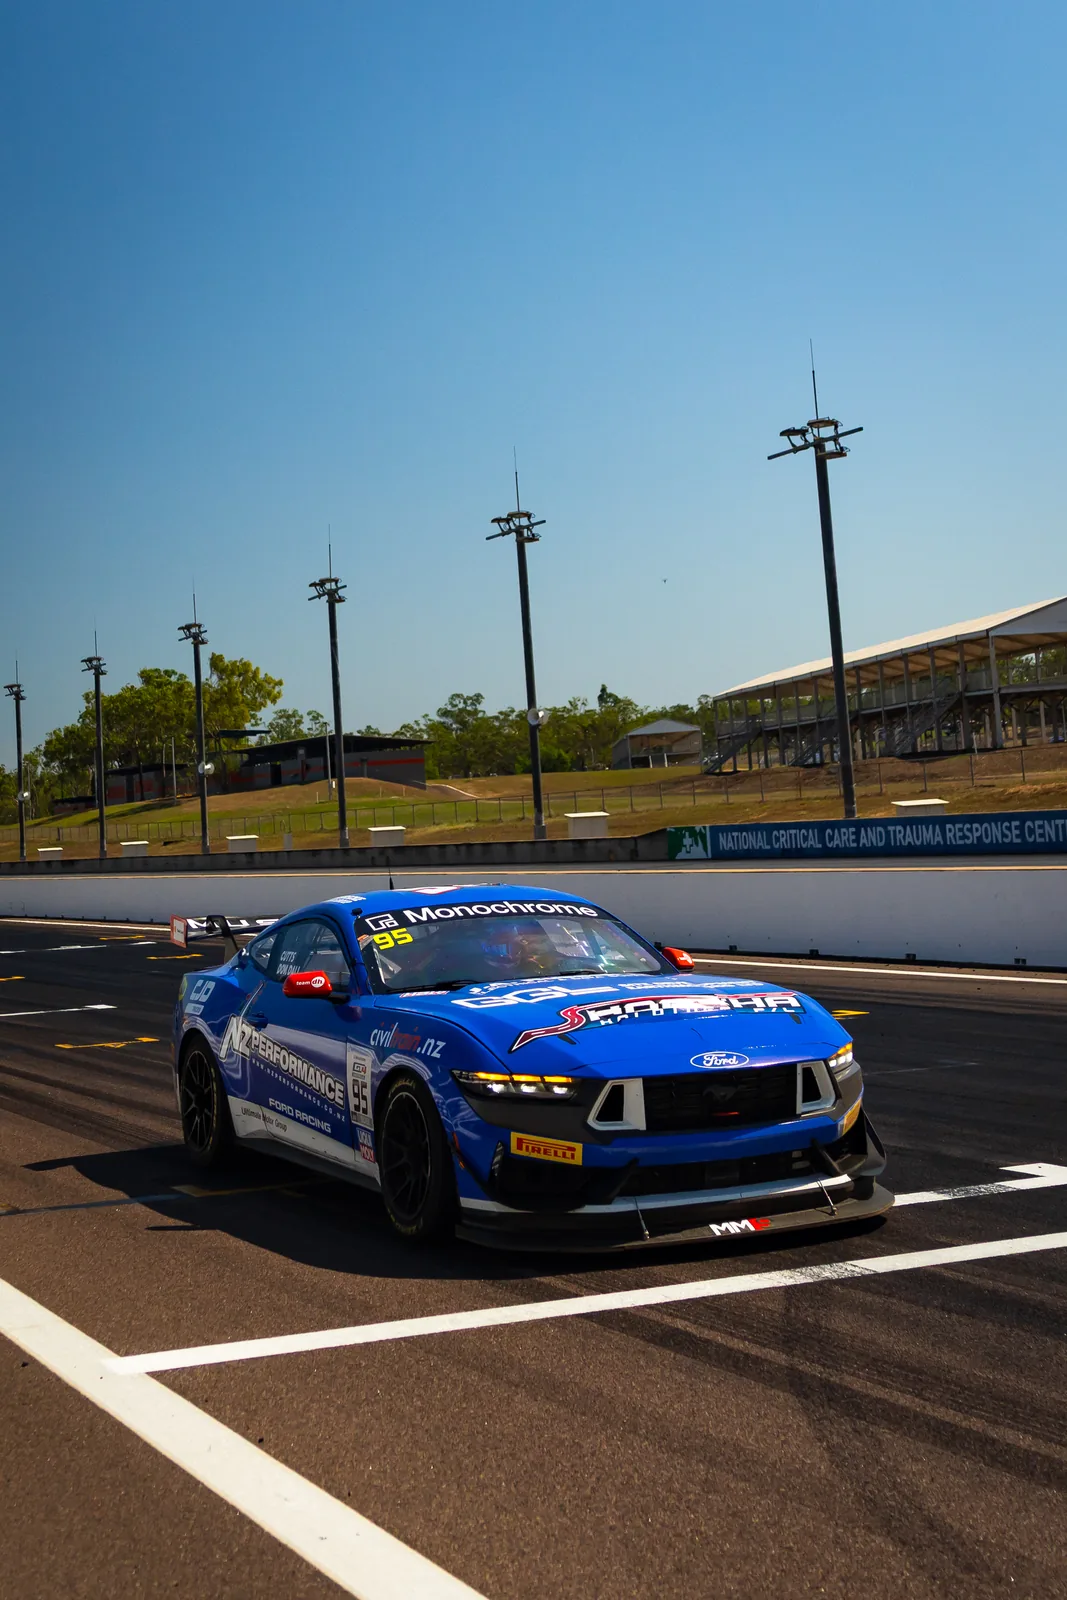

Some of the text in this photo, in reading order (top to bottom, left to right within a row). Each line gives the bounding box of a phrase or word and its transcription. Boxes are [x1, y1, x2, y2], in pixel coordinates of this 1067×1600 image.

[719, 819, 1067, 850] NATIONAL CRITICAL CARE AND TRAUMA RESPONSE CENT
[403, 901, 599, 923] Monochrome
[373, 928, 414, 950] 95
[703, 1053, 738, 1067] Ford
[352, 1078, 368, 1115] 95
[268, 1098, 294, 1117] FORD
[295, 1109, 332, 1133] RACING
[516, 1137, 577, 1160] PIRELLI
